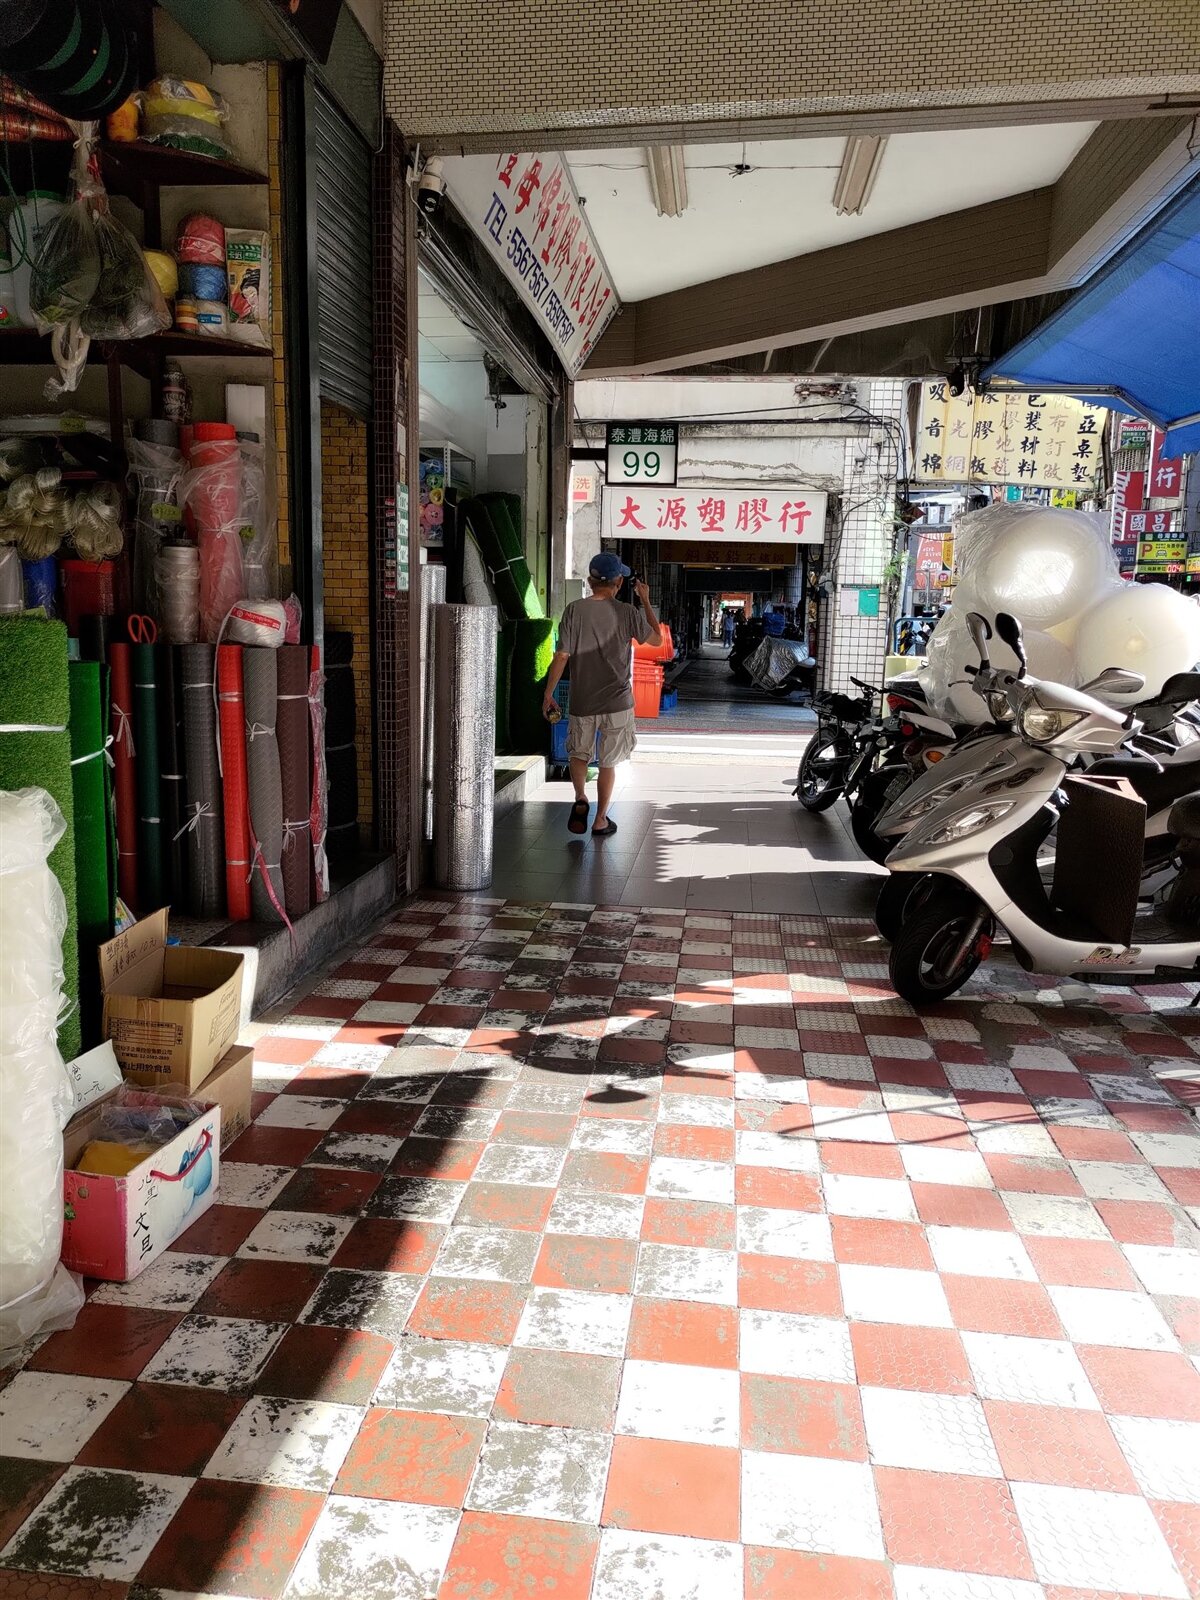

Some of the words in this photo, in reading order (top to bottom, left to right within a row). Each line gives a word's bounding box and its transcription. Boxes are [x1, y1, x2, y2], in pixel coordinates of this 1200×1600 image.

[611, 427, 675, 443] 泰灃海綿
[922, 383, 949, 474] 吸音棉
[945, 393, 969, 474] 光網
[623, 451, 660, 478] 99
[616, 495, 812, 535] 大源塑膠行
